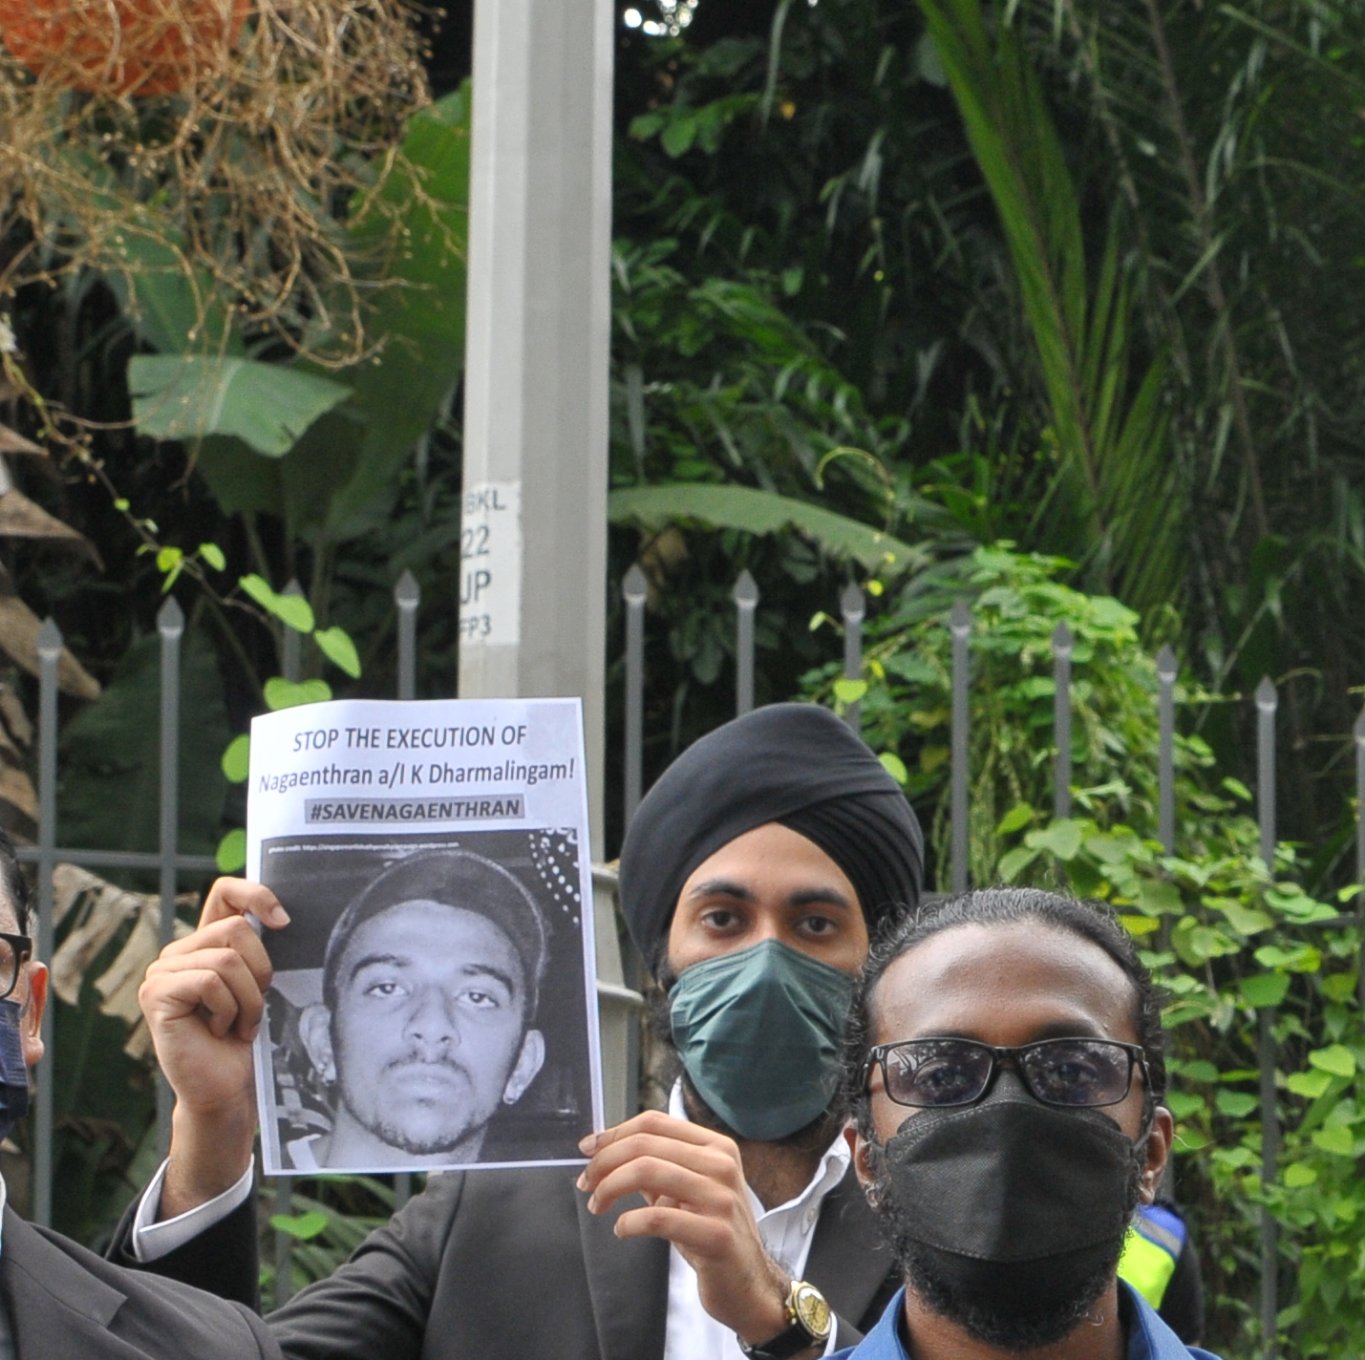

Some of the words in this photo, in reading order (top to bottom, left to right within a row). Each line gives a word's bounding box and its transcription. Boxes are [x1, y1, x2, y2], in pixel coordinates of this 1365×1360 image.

[293, 728, 338, 752] STOP
[345, 727, 380, 748] THE
[386, 725, 495, 749] EXECUTION
[501, 725, 527, 745] OF
[258, 762, 372, 794] Nagaenthran
[411, 763, 423, 785] K
[429, 758, 575, 786] Dharmalingam!
[310, 799, 520, 821] #SAVENAGAENTHRAN
